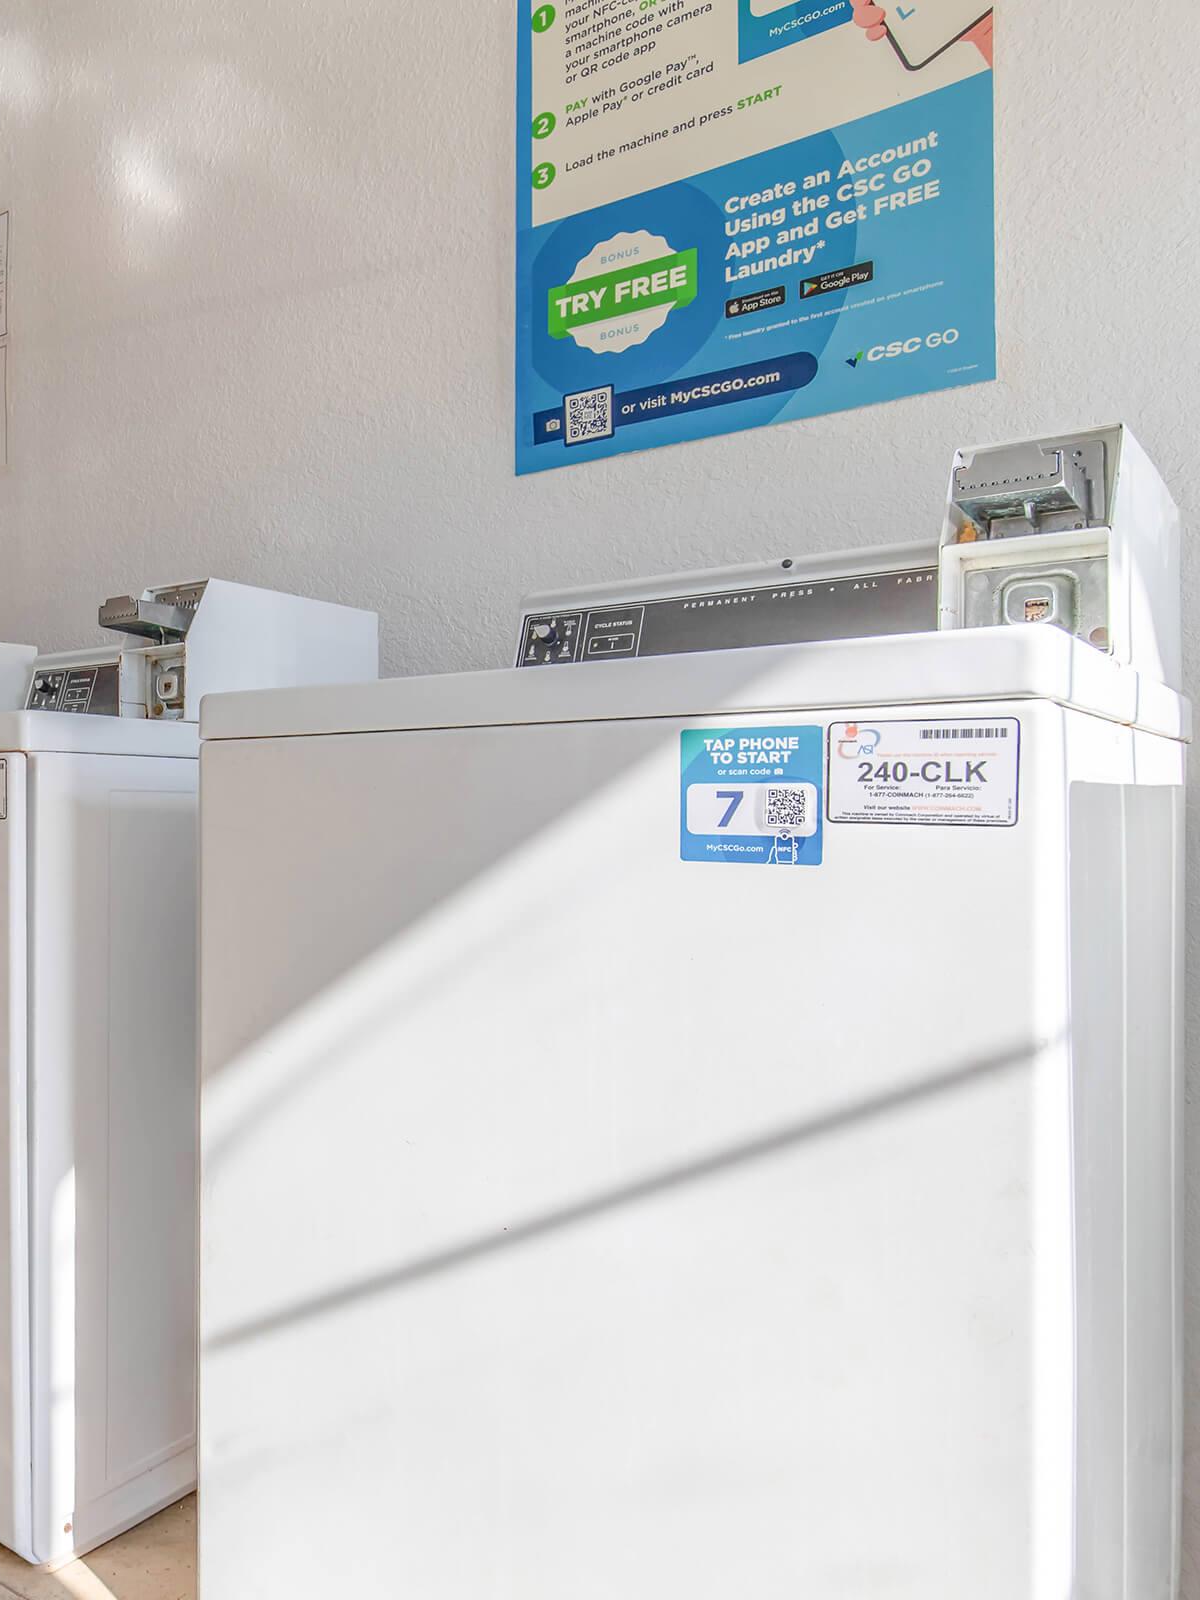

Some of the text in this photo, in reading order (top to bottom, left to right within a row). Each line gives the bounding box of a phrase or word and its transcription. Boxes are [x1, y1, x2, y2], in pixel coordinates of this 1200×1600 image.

[539, 11, 547, 26] 1
[565, 15, 589, 33] your
[565, 9, 635, 44] smartphone,
[565, 0, 684, 58] a machine code with
[769, 1, 845, 37] MyCSCGO.com
[565, 3, 713, 72] your smartphone camera
[565, 40, 656, 84] or QR code app
[565, 97, 588, 114] PAY
[592, 87, 616, 104] with
[619, 69, 662, 92] Google
[566, 108, 599, 127] Apple
[631, 92, 643, 102] or
[647, 76, 682, 97] credit
[686, 61, 714, 80] card
[538, 119, 548, 135] 2
[565, 85, 783, 172] Load the machine and press START
[538, 168, 549, 185] 3
[725, 130, 939, 214] Create an Account
[725, 158, 932, 236] Using the CSC GO
[725, 179, 941, 260] App and Get FREE
[600, 246, 640, 265] BONUS
[556, 265, 688, 318] TRY FREE
[821, 271, 869, 290] Google Play
[741, 295, 781, 313] App Store
[600, 323, 640, 341] BONUS
[867, 328, 960, 362] CSC GO
[621, 371, 781, 415] or visit MyCSCGO.com
[683, 574, 933, 609] PERMANENT PRESS ALL FABR
[704, 736, 799, 751] TAP PHONE
[710, 751, 792, 764] TO START
[728, 768, 748, 776] scan
[749, 767, 771, 776] code
[857, 760, 988, 783] 240-CLK
[716, 790, 744, 828] 7
[706, 844, 764, 853] MyCSCGo.com
